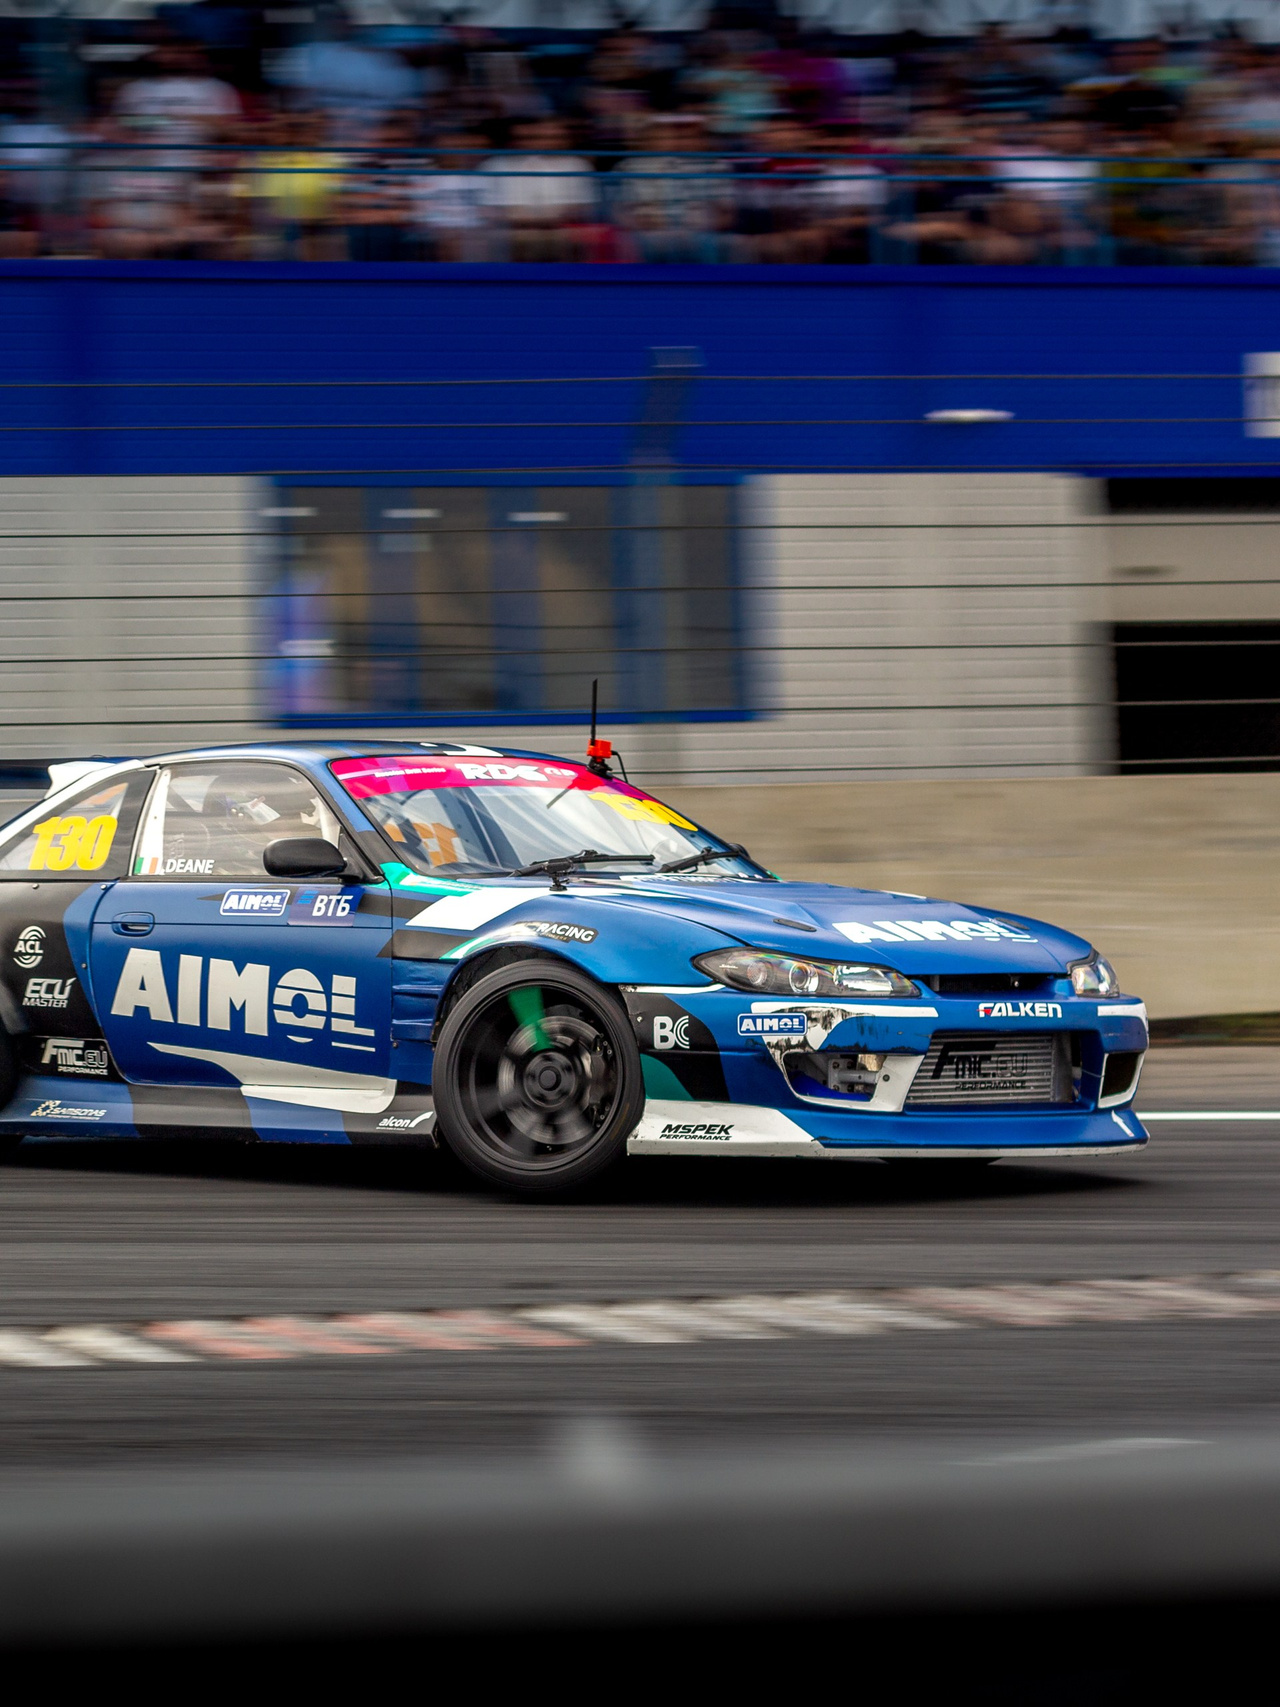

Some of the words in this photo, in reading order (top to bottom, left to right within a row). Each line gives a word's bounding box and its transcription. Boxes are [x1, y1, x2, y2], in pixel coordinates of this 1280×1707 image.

[455, 762, 549, 782] RDS
[28, 815, 118, 871] 130
[223, 894, 283, 911] AIMOL
[312, 895, 354, 917] ВТБ
[536, 922, 595, 942] RACING
[832, 920, 1038, 943] AIMOL
[14, 940, 44, 954] ACL
[25, 977, 77, 999] ECU
[22, 998, 68, 1009] MASTER
[110, 947, 376, 1052] AIMOL
[977, 1002, 1063, 1019] FALKEN
[653, 1015, 690, 1050] BC
[740, 1017, 804, 1032] AIMOL
[57, 1065, 109, 1076] PERFORMANCE
[955, 1081, 1027, 1091] PERFORMANCE
[378, 1115, 411, 1128] alcon
[661, 1123, 735, 1135] MSPEK
[658, 1133, 732, 1141] PERFORMANCE
